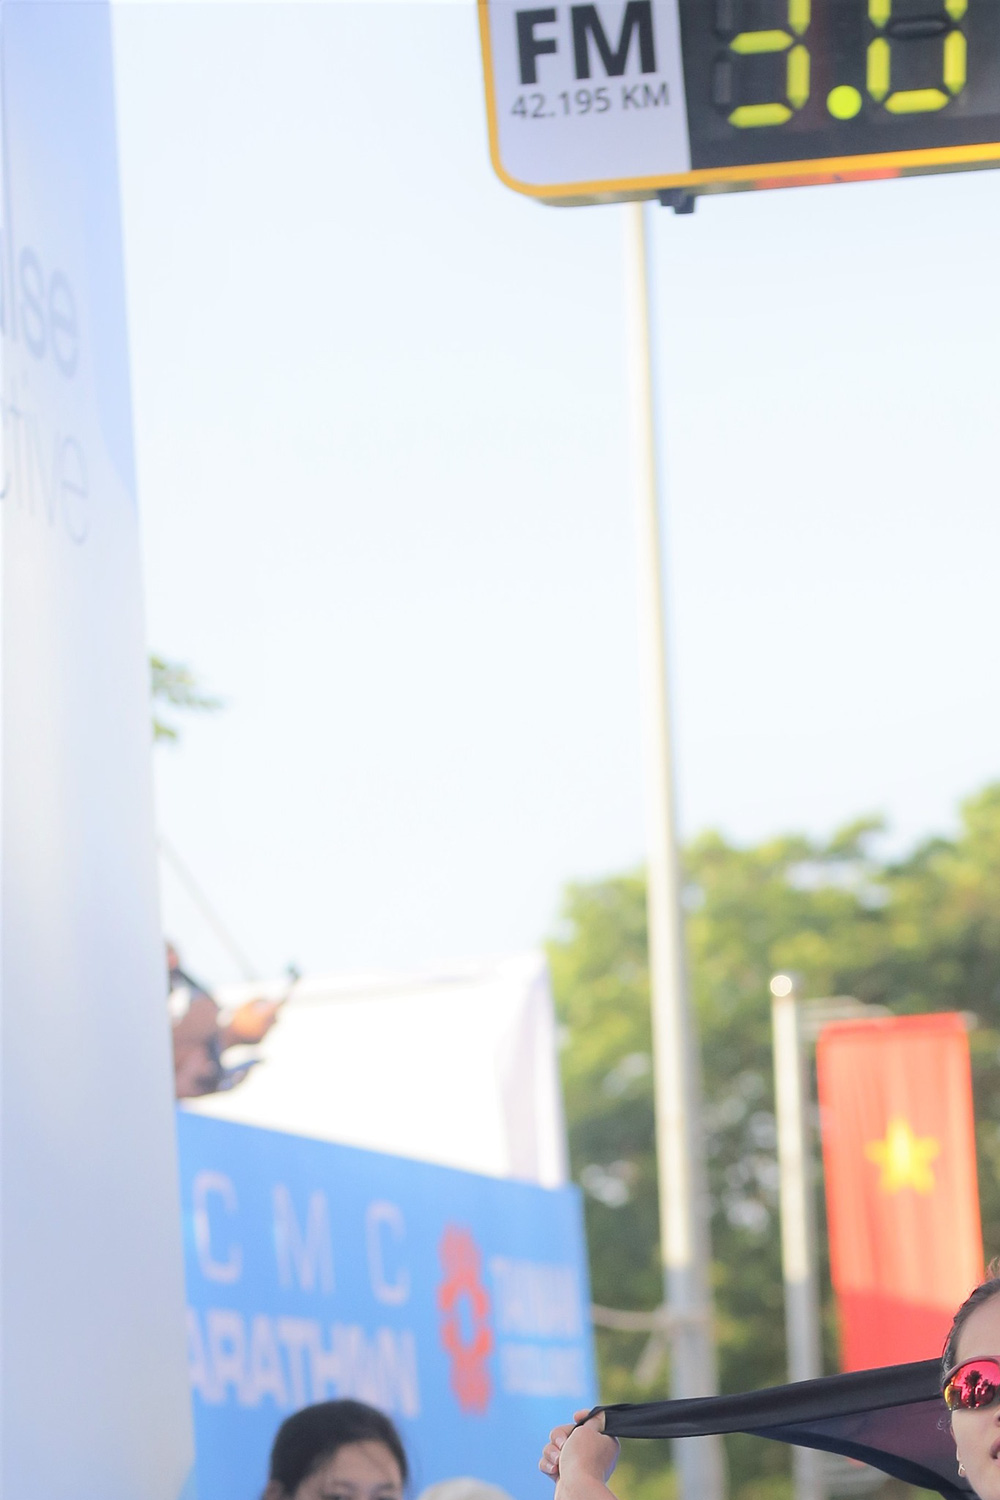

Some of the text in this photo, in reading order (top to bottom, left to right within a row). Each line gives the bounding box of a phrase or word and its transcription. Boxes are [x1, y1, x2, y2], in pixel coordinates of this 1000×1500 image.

[516, 0, 656, 85] FM
[511, 81, 670, 119] 42.195 KM
